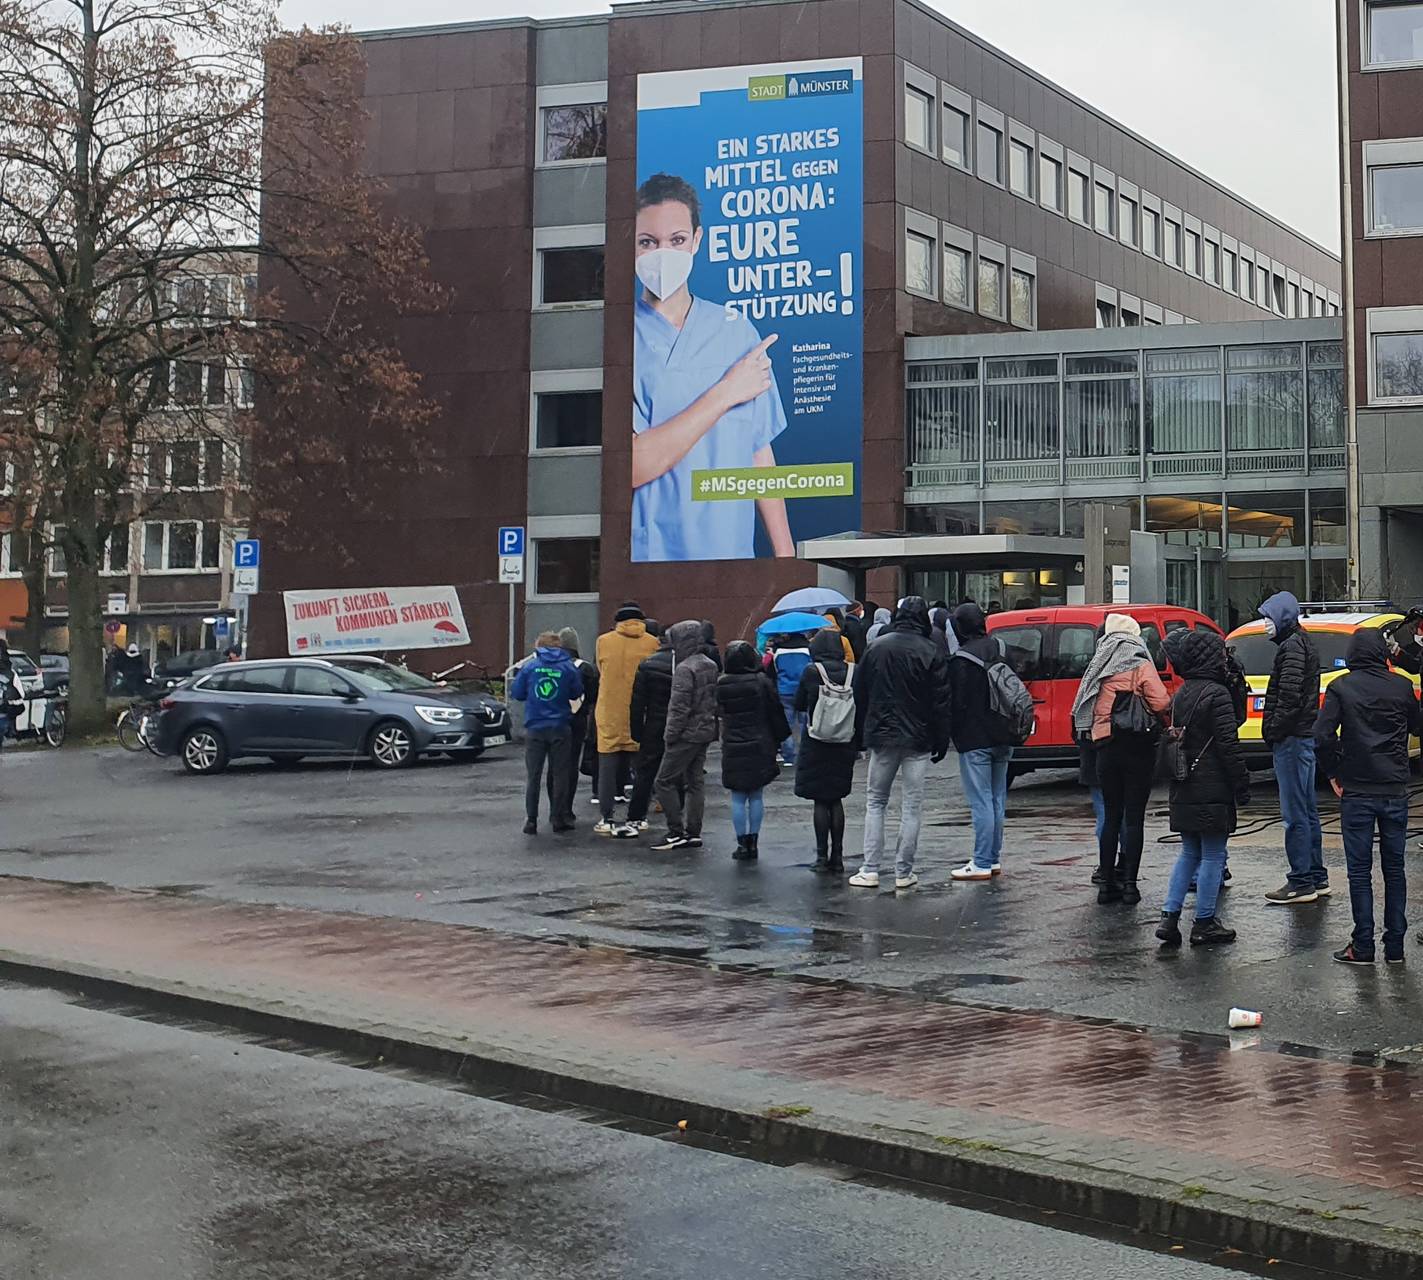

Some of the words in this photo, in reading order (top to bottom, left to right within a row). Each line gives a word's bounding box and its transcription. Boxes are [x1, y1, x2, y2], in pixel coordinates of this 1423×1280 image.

[752, 84, 784, 97] STADT
[800, 79, 849, 94] MÜNSTER
[717, 137, 749, 160] EIN
[755, 127, 840, 156] STARKES
[705, 158, 788, 190] MITTEL
[792, 158, 839, 178] GEGEN
[720, 181, 836, 218] CORONA:
[708, 218, 801, 263] EURE
[727, 259, 833, 294] UNTER-
[792, 341, 832, 353] Katharina
[792, 351, 854, 364] Fachgesundheits-
[792, 365, 807, 374] und
[808, 363, 840, 373] Kranken-
[793, 374, 825, 386] pflegerin
[825, 373, 836, 381] für
[793, 385, 821, 395] Intensiv
[822, 383, 837, 392] und
[793, 394, 832, 405] Anästhesie
[793, 407, 806, 415] am
[806, 404, 824, 414] UKM
[699, 473, 845, 494] #MSgegenCorona
[504, 531, 518, 552] P
[240, 543, 253, 565] P
[1074, 561, 1084, 573] 4
[292, 597, 341, 621] ZUKUNFT
[342, 591, 395, 613] SICHERN.
[335, 608, 399, 633] KOMMUNEN
[400, 601, 454, 623] STÄRKEN!
